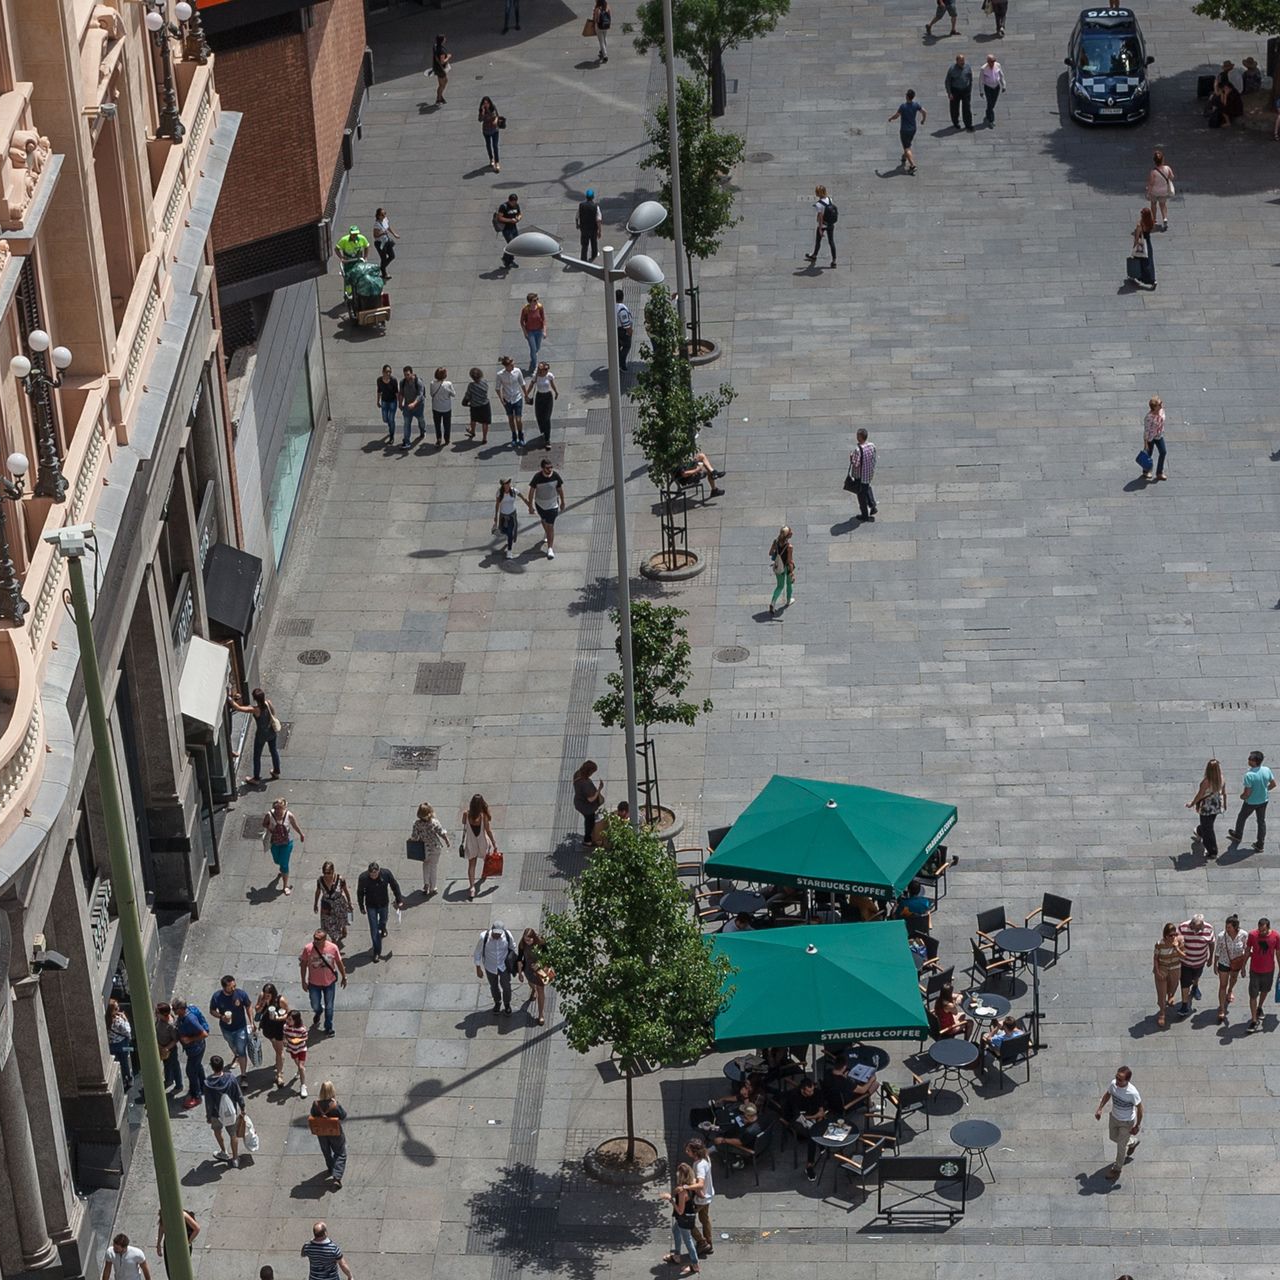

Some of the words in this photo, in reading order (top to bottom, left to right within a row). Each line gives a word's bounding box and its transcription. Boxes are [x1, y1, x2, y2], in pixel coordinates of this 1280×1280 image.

[796, 877, 850, 891] STARBUCKS
[851, 884, 886, 896] COFFEE
[820, 1030, 881, 1040] STARBUCKS
[882, 1029, 921, 1037] COFFEE
